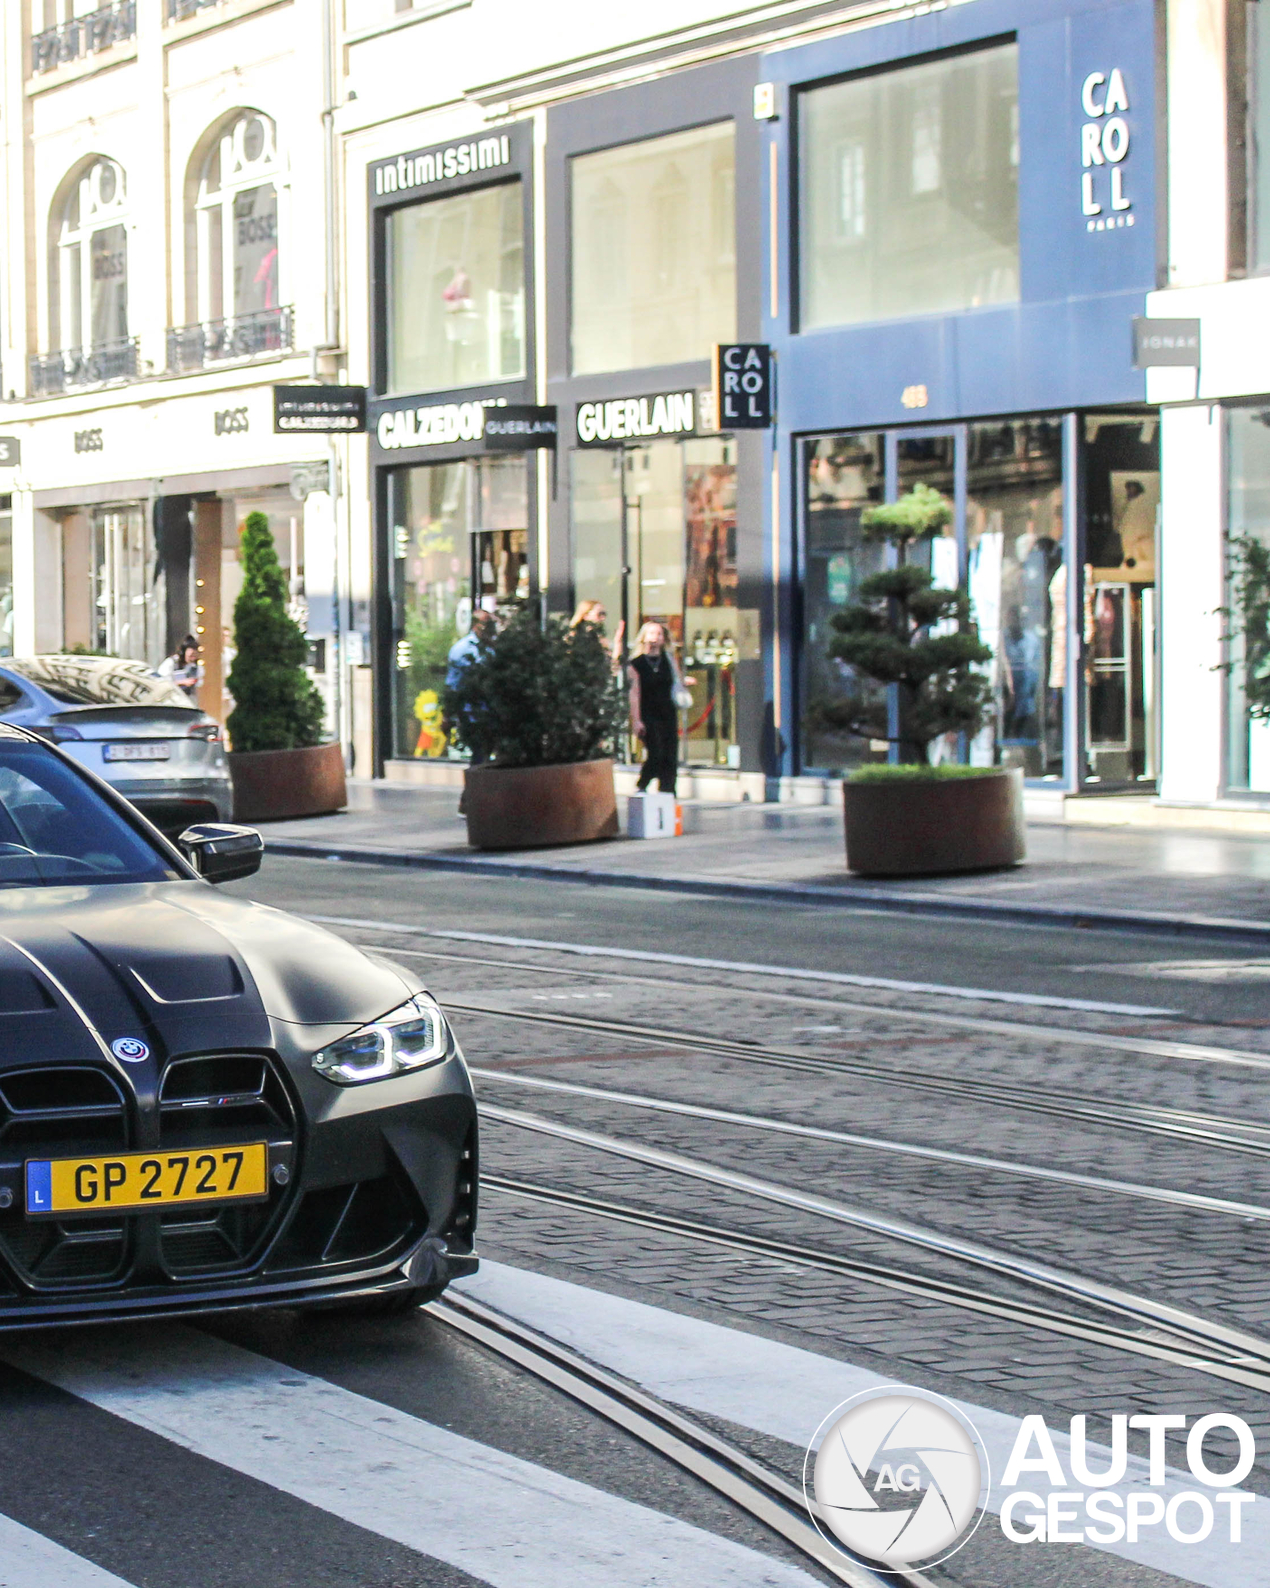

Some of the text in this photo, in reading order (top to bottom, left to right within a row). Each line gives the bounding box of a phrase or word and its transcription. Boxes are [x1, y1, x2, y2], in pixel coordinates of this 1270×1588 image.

[375, 134, 510, 195] intimissimi
[486, 420, 557, 435] GUERLAIN
[577, 392, 694, 442] GUERLAIN
[35, 1151, 245, 1204] L GP 2727
